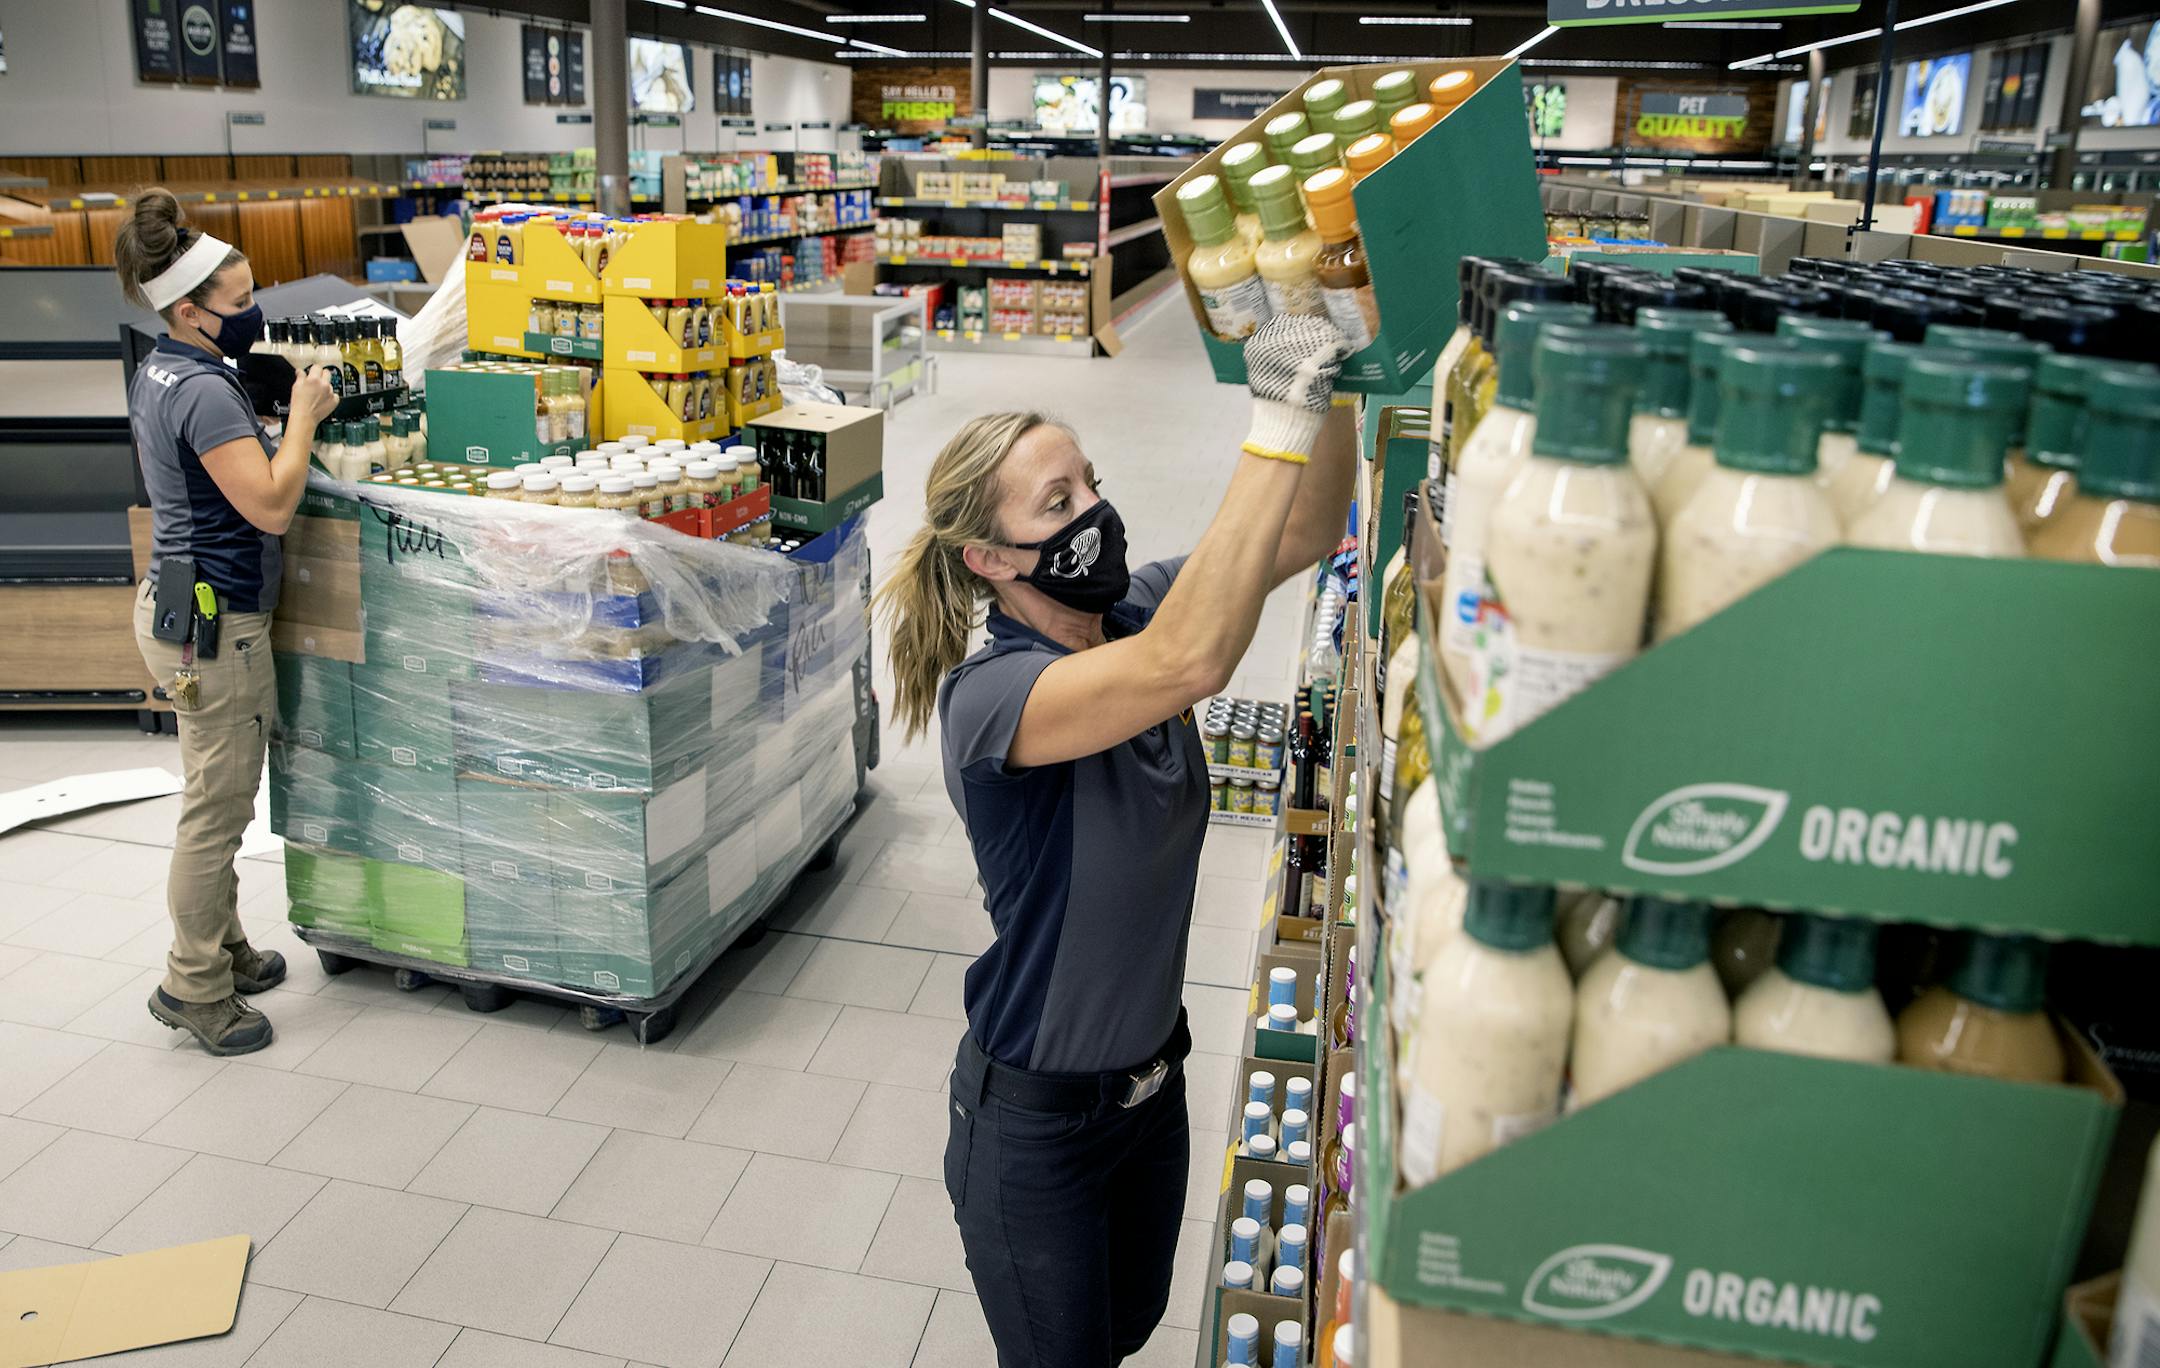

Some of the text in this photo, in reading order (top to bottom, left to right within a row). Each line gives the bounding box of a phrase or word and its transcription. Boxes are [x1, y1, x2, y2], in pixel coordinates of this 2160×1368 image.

[881, 85, 902, 97] SAY
[904, 86, 939, 98] HELLO
[881, 102, 956, 121] FRESH
[1678, 96, 1708, 114] PET
[1636, 116, 1747, 139] QUALITY
[778, 510, 809, 525] NON-GMO
[1240, 769, 1273, 777] MEXICAN
[1240, 815, 1272, 823] MEXICAN
[1800, 804, 2018, 879] ORGANIC
[1683, 1268, 1883, 1343] ORGANIC
